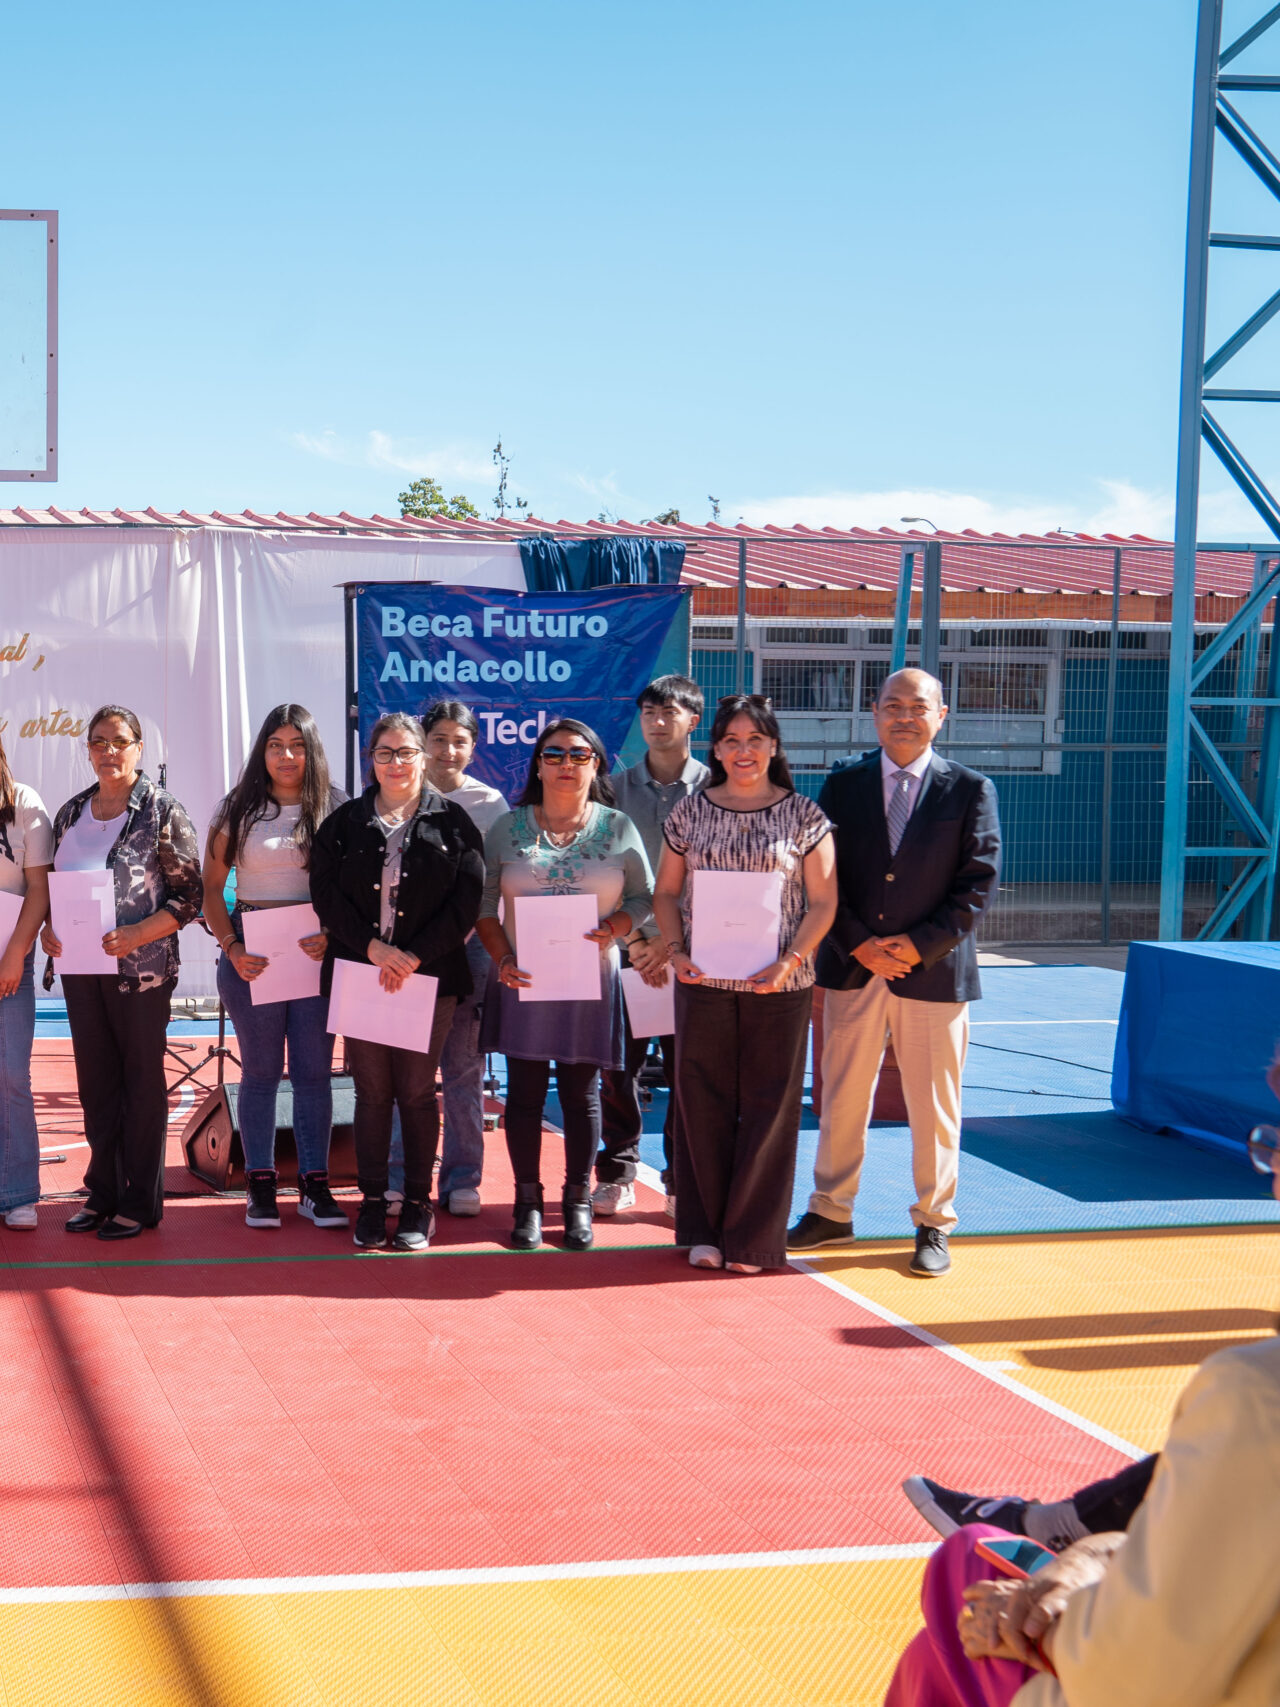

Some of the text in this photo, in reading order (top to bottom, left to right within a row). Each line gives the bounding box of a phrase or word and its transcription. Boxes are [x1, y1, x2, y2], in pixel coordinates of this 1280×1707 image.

[381, 606, 609, 638] Beca Futuro
[379, 650, 573, 683] Andacollo
[20, 708, 90, 738] artes
